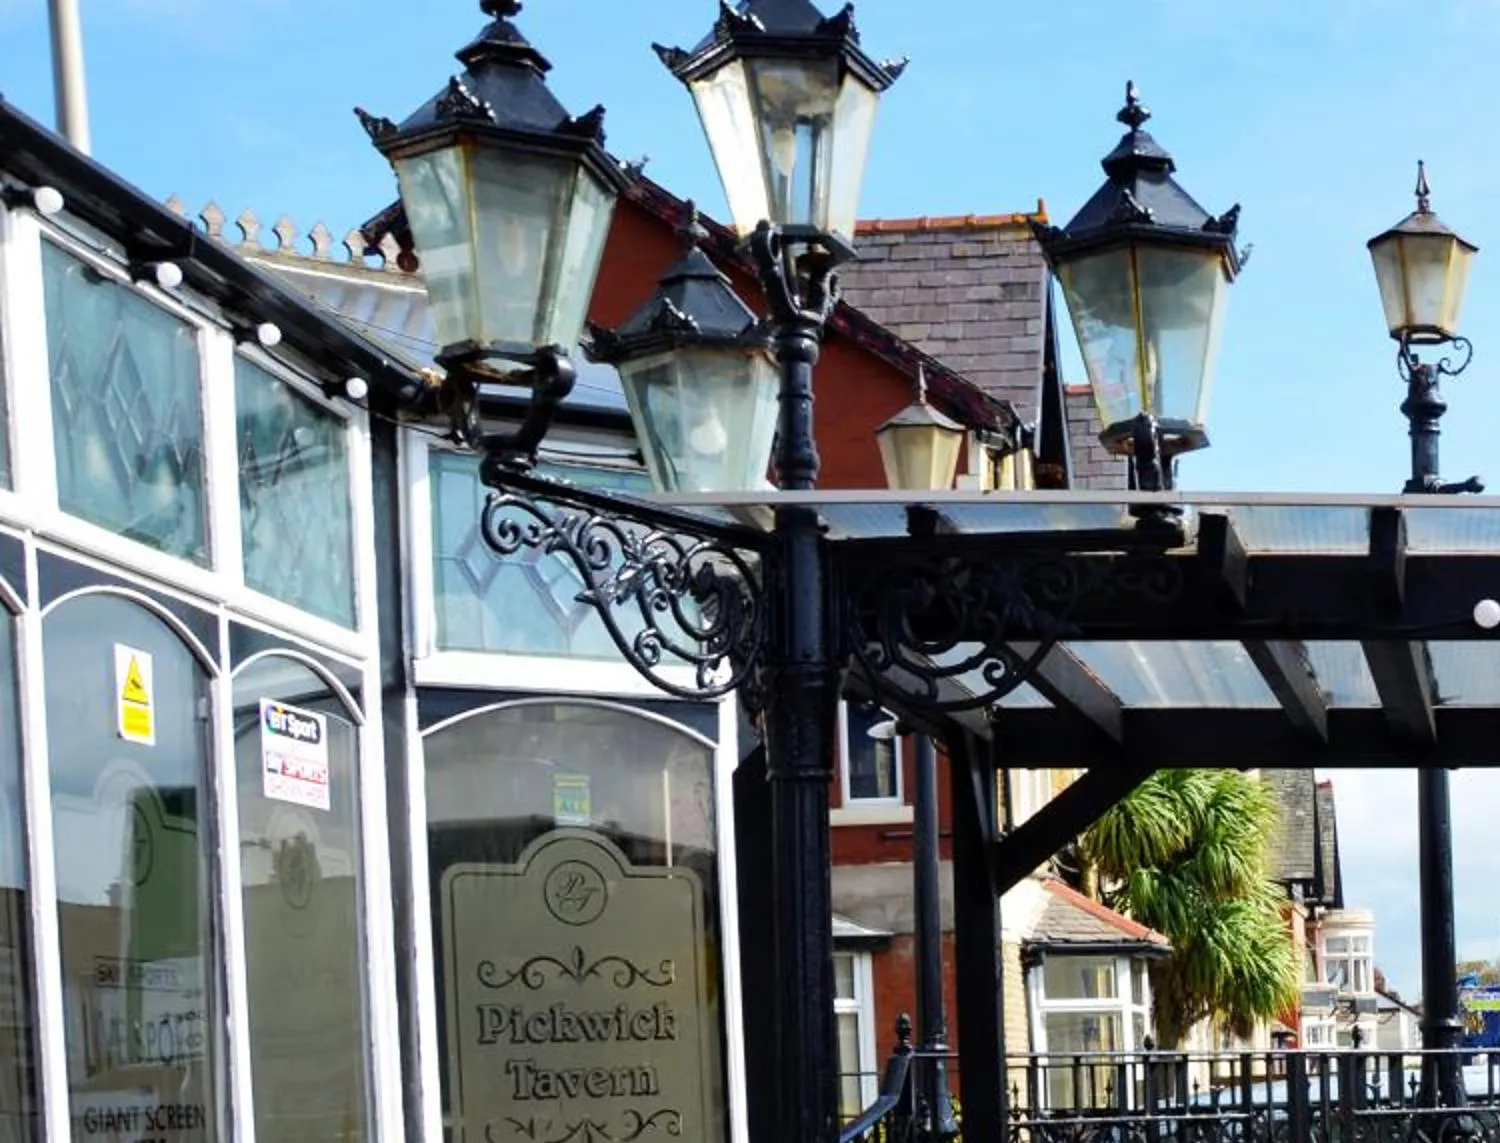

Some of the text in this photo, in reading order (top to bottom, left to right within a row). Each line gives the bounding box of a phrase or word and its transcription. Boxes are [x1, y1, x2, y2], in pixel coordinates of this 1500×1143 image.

[476, 1001, 678, 1044] Pickwick
[505, 1058, 660, 1102] Tavern
[84, 1103, 206, 1134] GIANT SCREEN
